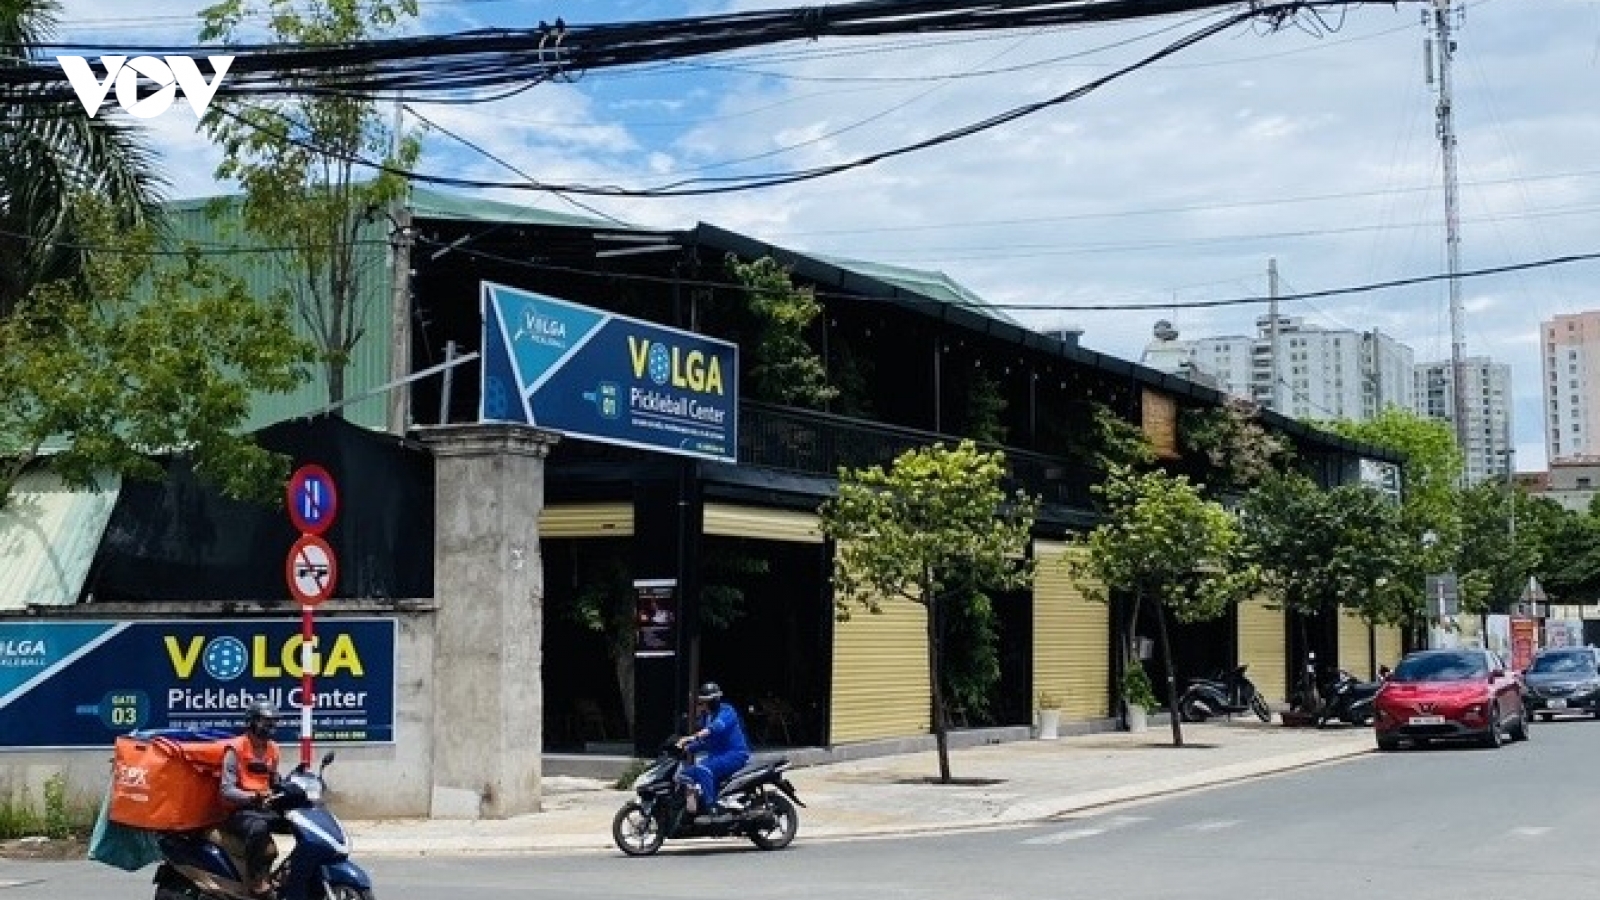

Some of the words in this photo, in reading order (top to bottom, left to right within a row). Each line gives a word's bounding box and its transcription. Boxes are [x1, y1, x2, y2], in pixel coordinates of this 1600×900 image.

[627, 335, 724, 396] VOLGA
[630, 387, 689, 416] Pickleball
[688, 400, 726, 422] Center
[164, 633, 365, 680] VOLGA
[112, 707, 137, 725] 03
[288, 689, 367, 709] Cnter
